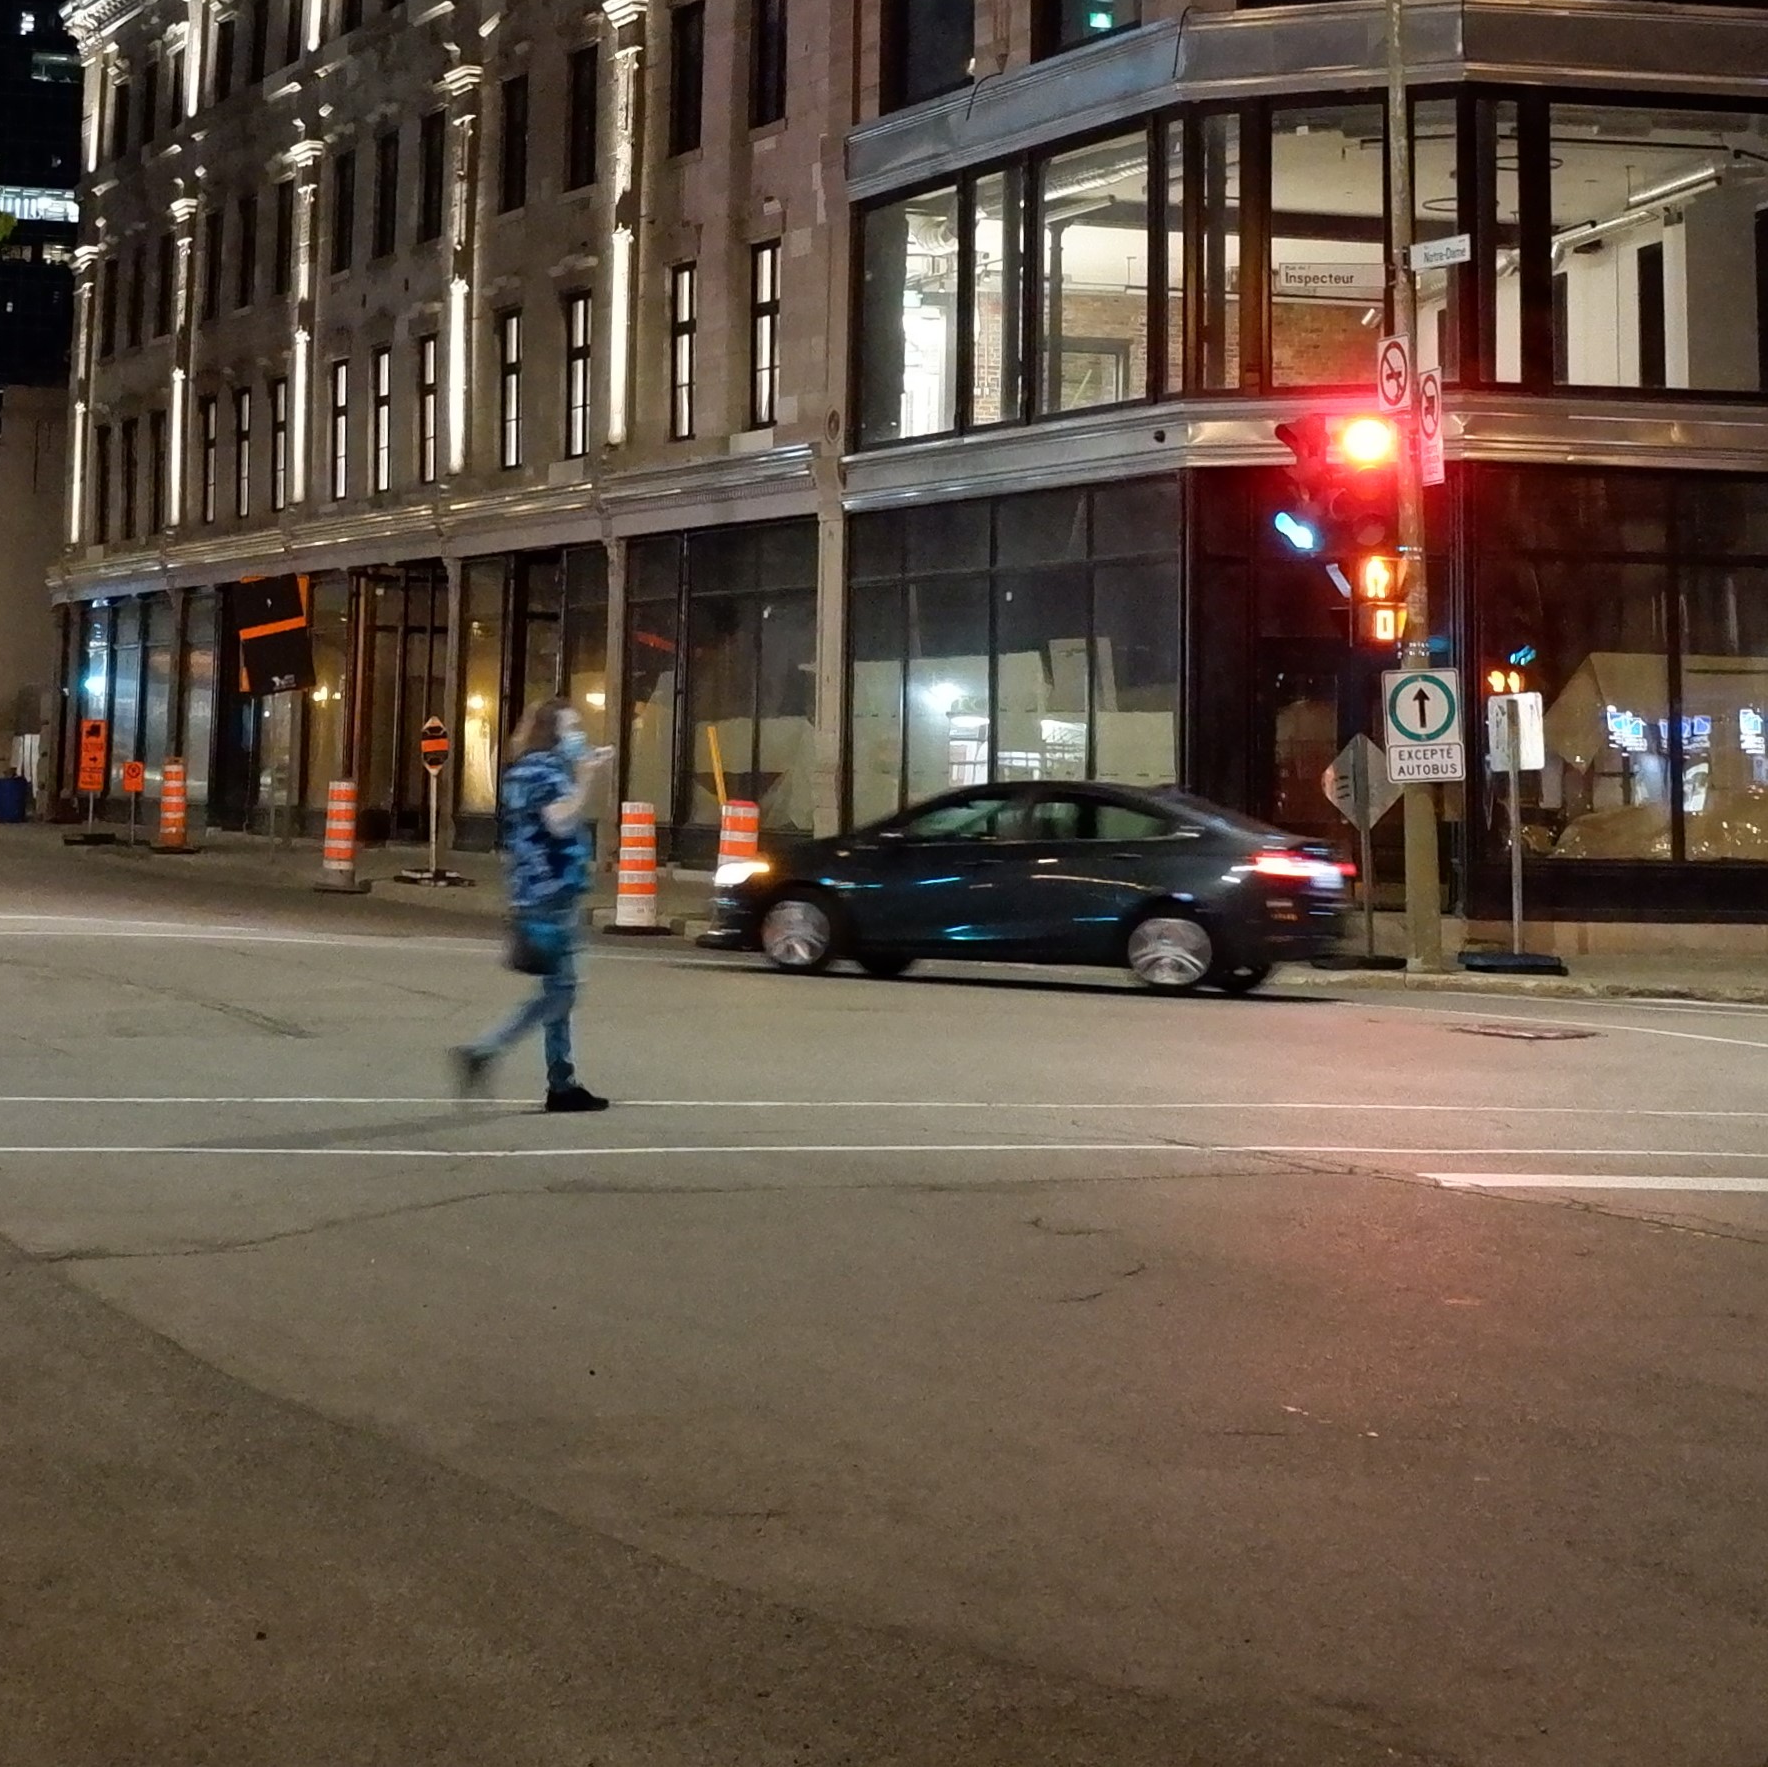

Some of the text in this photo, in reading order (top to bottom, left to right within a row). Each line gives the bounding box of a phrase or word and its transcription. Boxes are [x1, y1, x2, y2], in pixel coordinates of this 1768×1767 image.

[1423, 246, 1466, 264] Notre-Dame
[1285, 271, 1354, 287] Inspecteur
[1398, 746, 1454, 761] EXCEPTÉ
[1397, 763, 1457, 776] AUTOBUS
